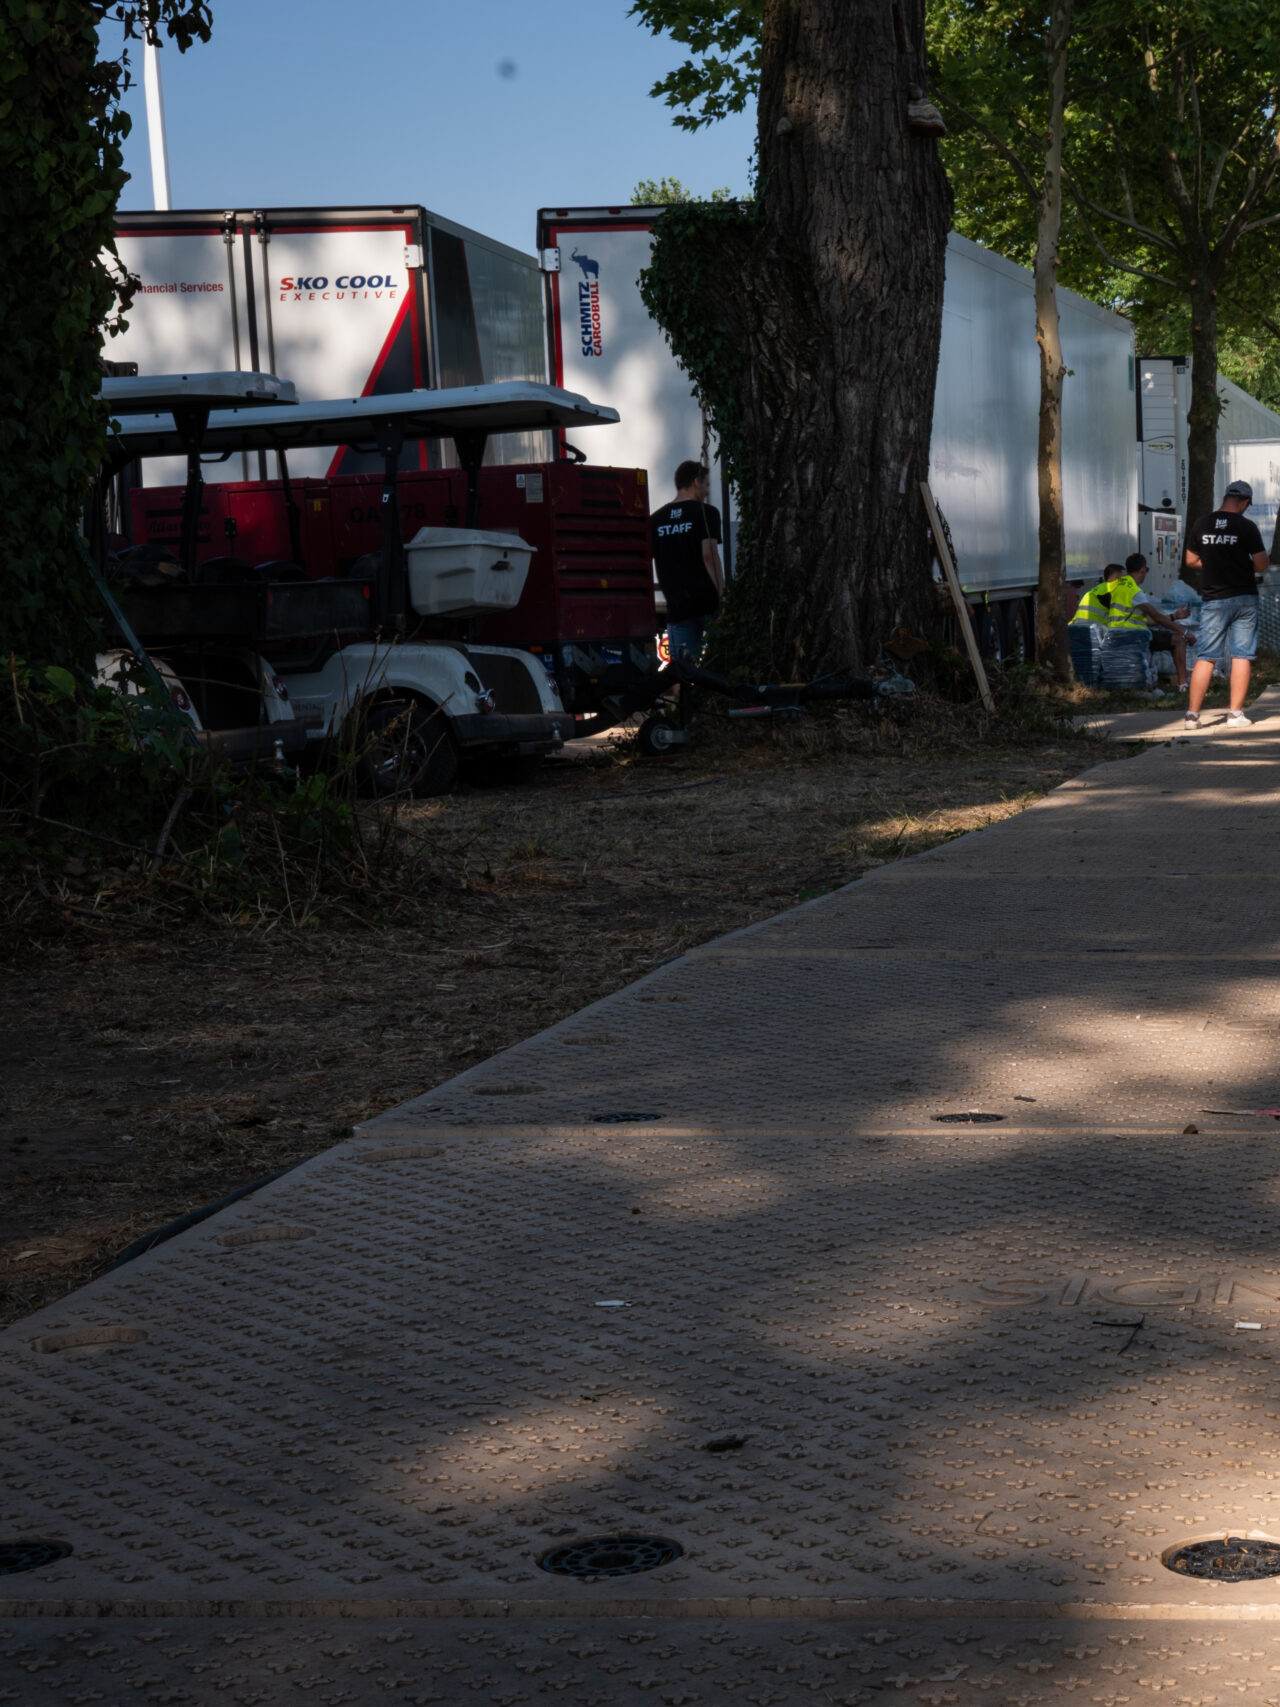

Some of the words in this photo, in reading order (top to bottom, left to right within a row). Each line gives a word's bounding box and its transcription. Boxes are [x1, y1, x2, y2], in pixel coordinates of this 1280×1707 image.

[138, 282, 177, 294] nancial
[180, 281, 224, 293] Services
[280, 276, 328, 291] S.KO
[335, 275, 398, 289] COOL
[280, 290, 397, 302] EXECUTIVE
[579, 281, 593, 357] SCHMITZ
[590, 281, 602, 357] CARGOBULL
[657, 522, 693, 537] STAFF
[1201, 534, 1238, 545] STAFF
